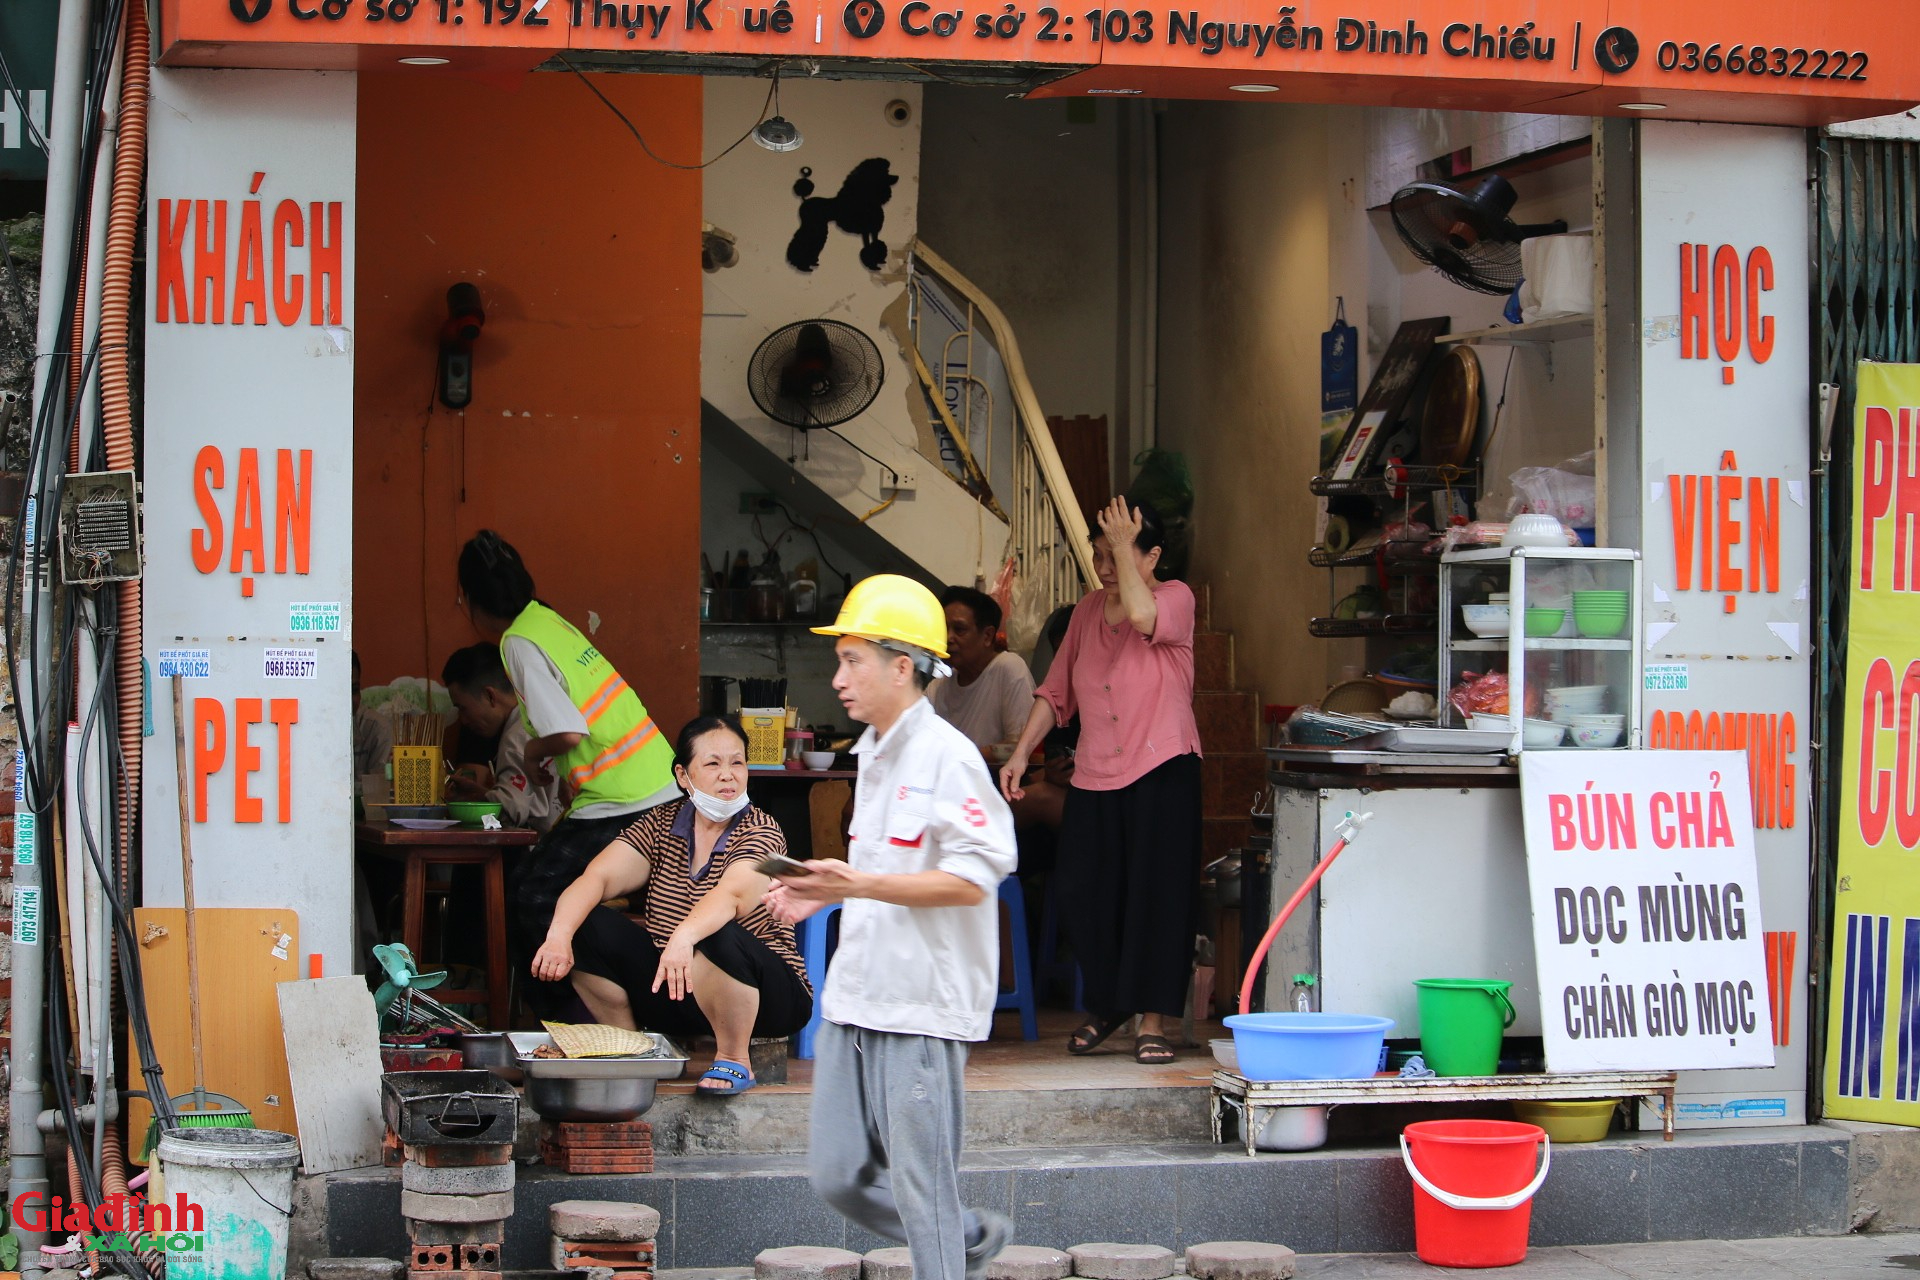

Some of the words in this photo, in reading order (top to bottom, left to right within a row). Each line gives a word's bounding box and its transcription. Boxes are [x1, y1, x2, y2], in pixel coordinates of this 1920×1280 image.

[478, 0, 549, 27] 192
[899, 1, 964, 38] Cơ
[973, 3, 1026, 40] sở
[1035, 7, 1074, 43] 2:
[1085, 9, 1154, 44] 103
[1167, 6, 1323, 57] Nguyễn
[1334, 17, 1428, 56] Đình
[1440, 21, 1556, 62] Chiểu
[1656, 40, 1868, 82] 0366832222
[156, 171, 343, 326] KHÁCH
[1680, 242, 1775, 386] HỌC
[191, 445, 313, 598] SẠN
[1669, 450, 1780, 614] VIỆN
[291, 615, 339, 631] 0936.118.637
[160, 661, 209, 677] 0984330.622
[266, 661, 315, 677] 0968.558.577
[1645, 675, 1688, 690] 0972.623.680
[194, 697, 299, 824] PET
[18, 814, 34, 864] 0936.118.637
[1548, 779, 1637, 852] BÚN
[1650, 771, 1735, 850] CHẢ
[21, 891, 37, 942] 0973.417.114
[1554, 886, 1628, 958] DỌC
[1638, 872, 1748, 943] MÙNG
[1563, 974, 1638, 1040] CHÂN
[1644, 969, 1689, 1037] GIÒ
[1698, 980, 1756, 1047] MỌC
[1838, 913, 1891, 1099] IN
